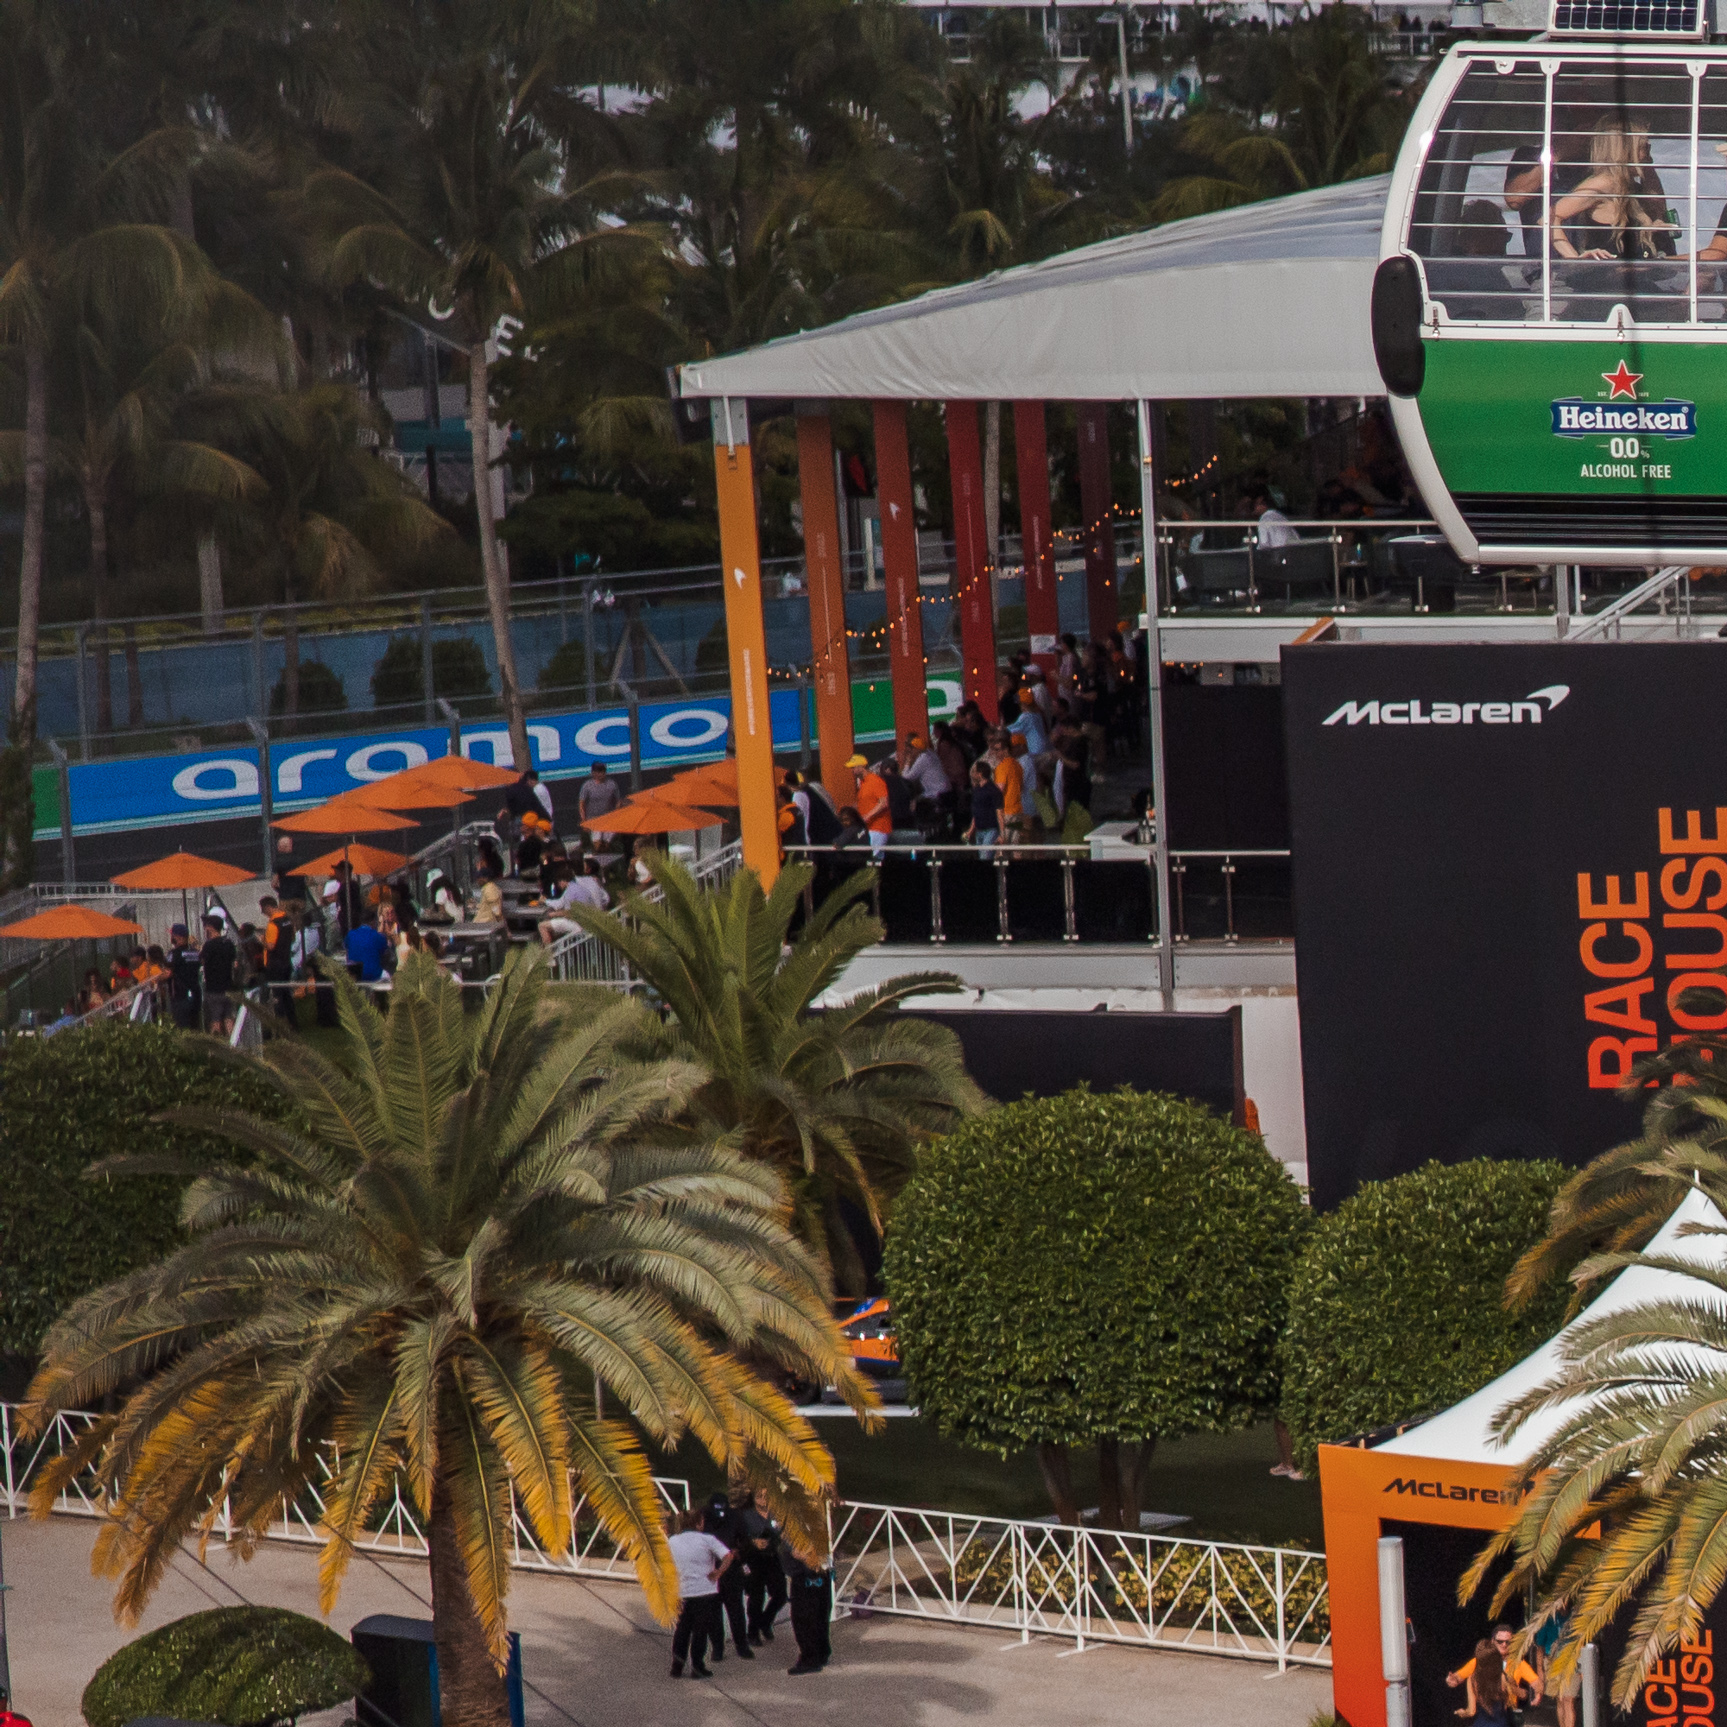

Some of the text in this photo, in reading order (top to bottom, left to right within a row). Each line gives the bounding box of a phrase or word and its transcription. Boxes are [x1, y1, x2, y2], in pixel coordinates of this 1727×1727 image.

[1581, 464, 1671, 479] ALCOHOL FREE
[1321, 699, 1543, 726] McLaren
[171, 709, 729, 801] aramco
[1577, 871, 1660, 1090] RACE
